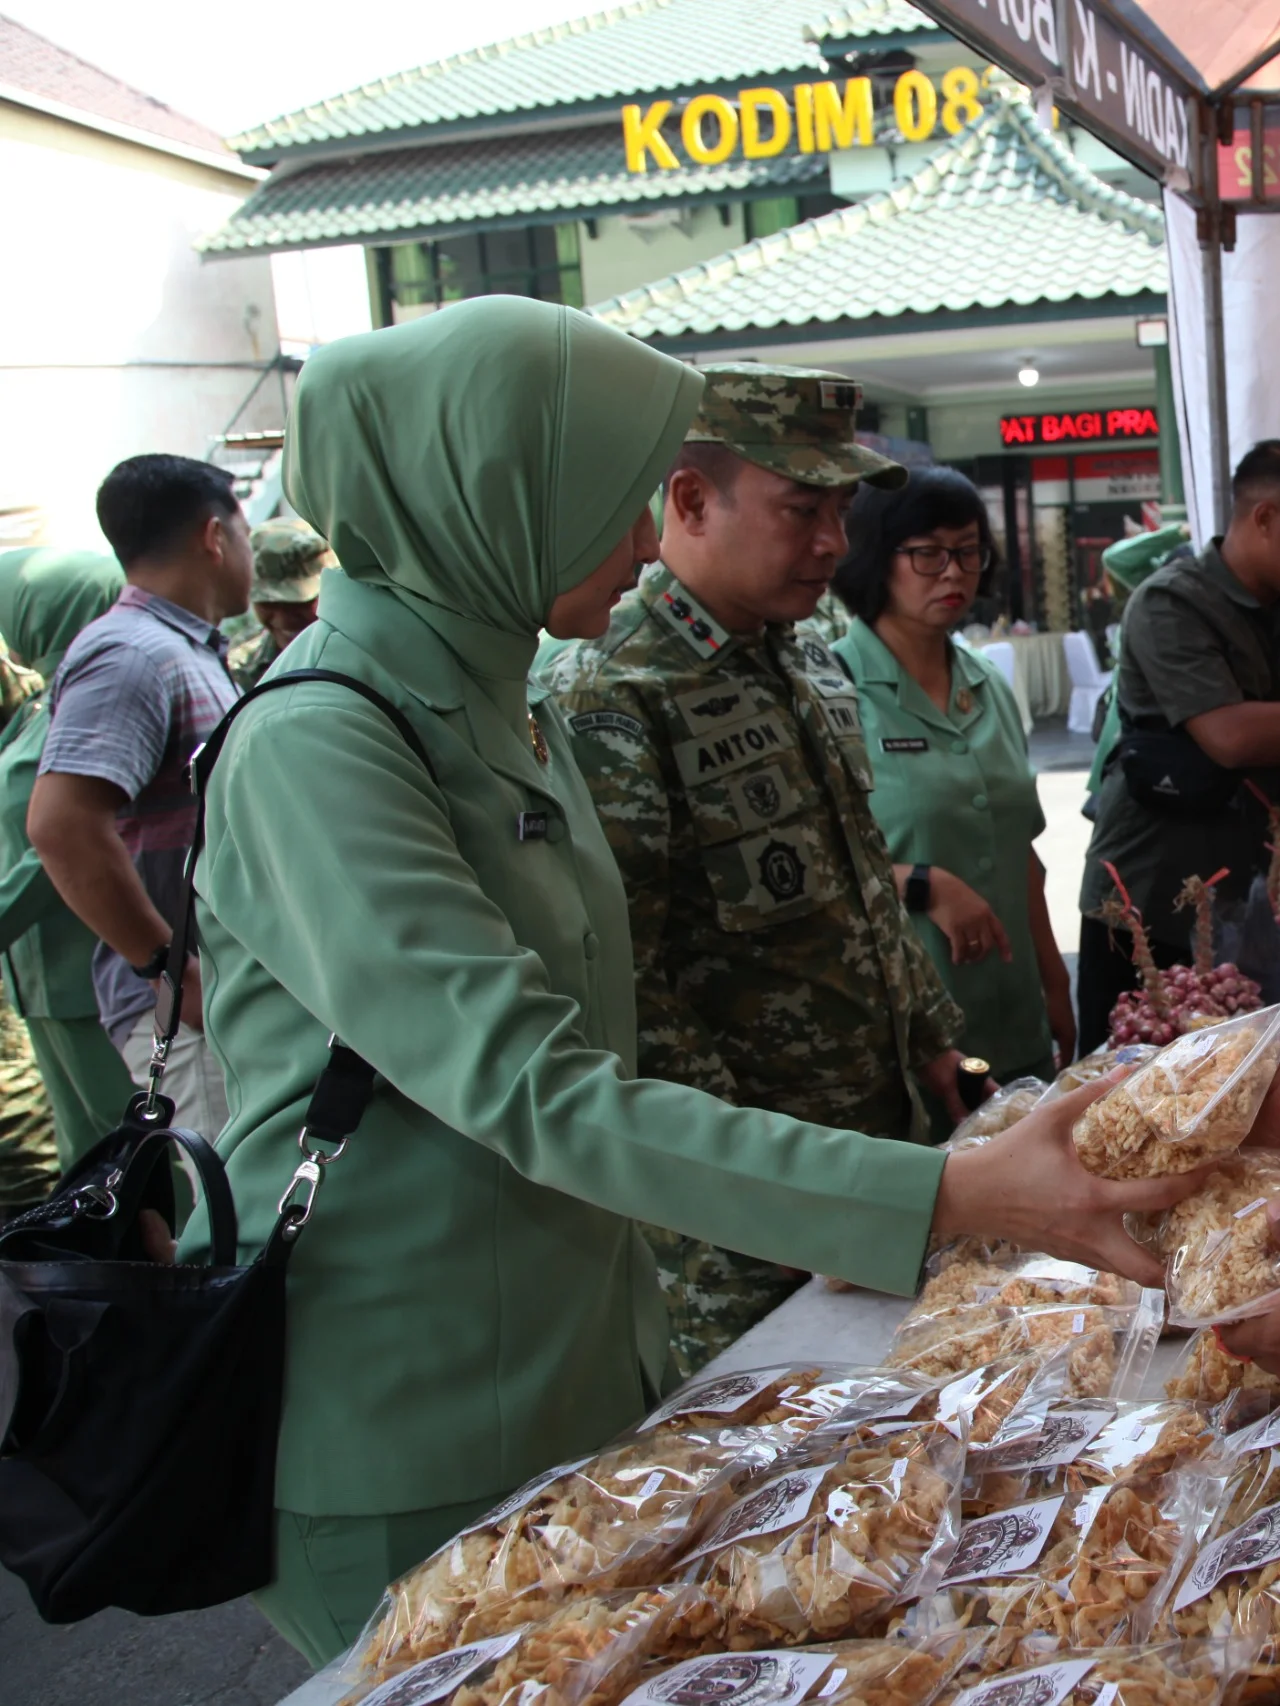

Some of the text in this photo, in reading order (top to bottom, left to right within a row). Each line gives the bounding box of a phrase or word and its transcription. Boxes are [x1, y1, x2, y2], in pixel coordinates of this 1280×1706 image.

[622, 76, 873, 172] KODIM
[1041, 412, 1102, 442] BAGI
[828, 706, 855, 729] TNI
[698, 723, 780, 773] ANTON
